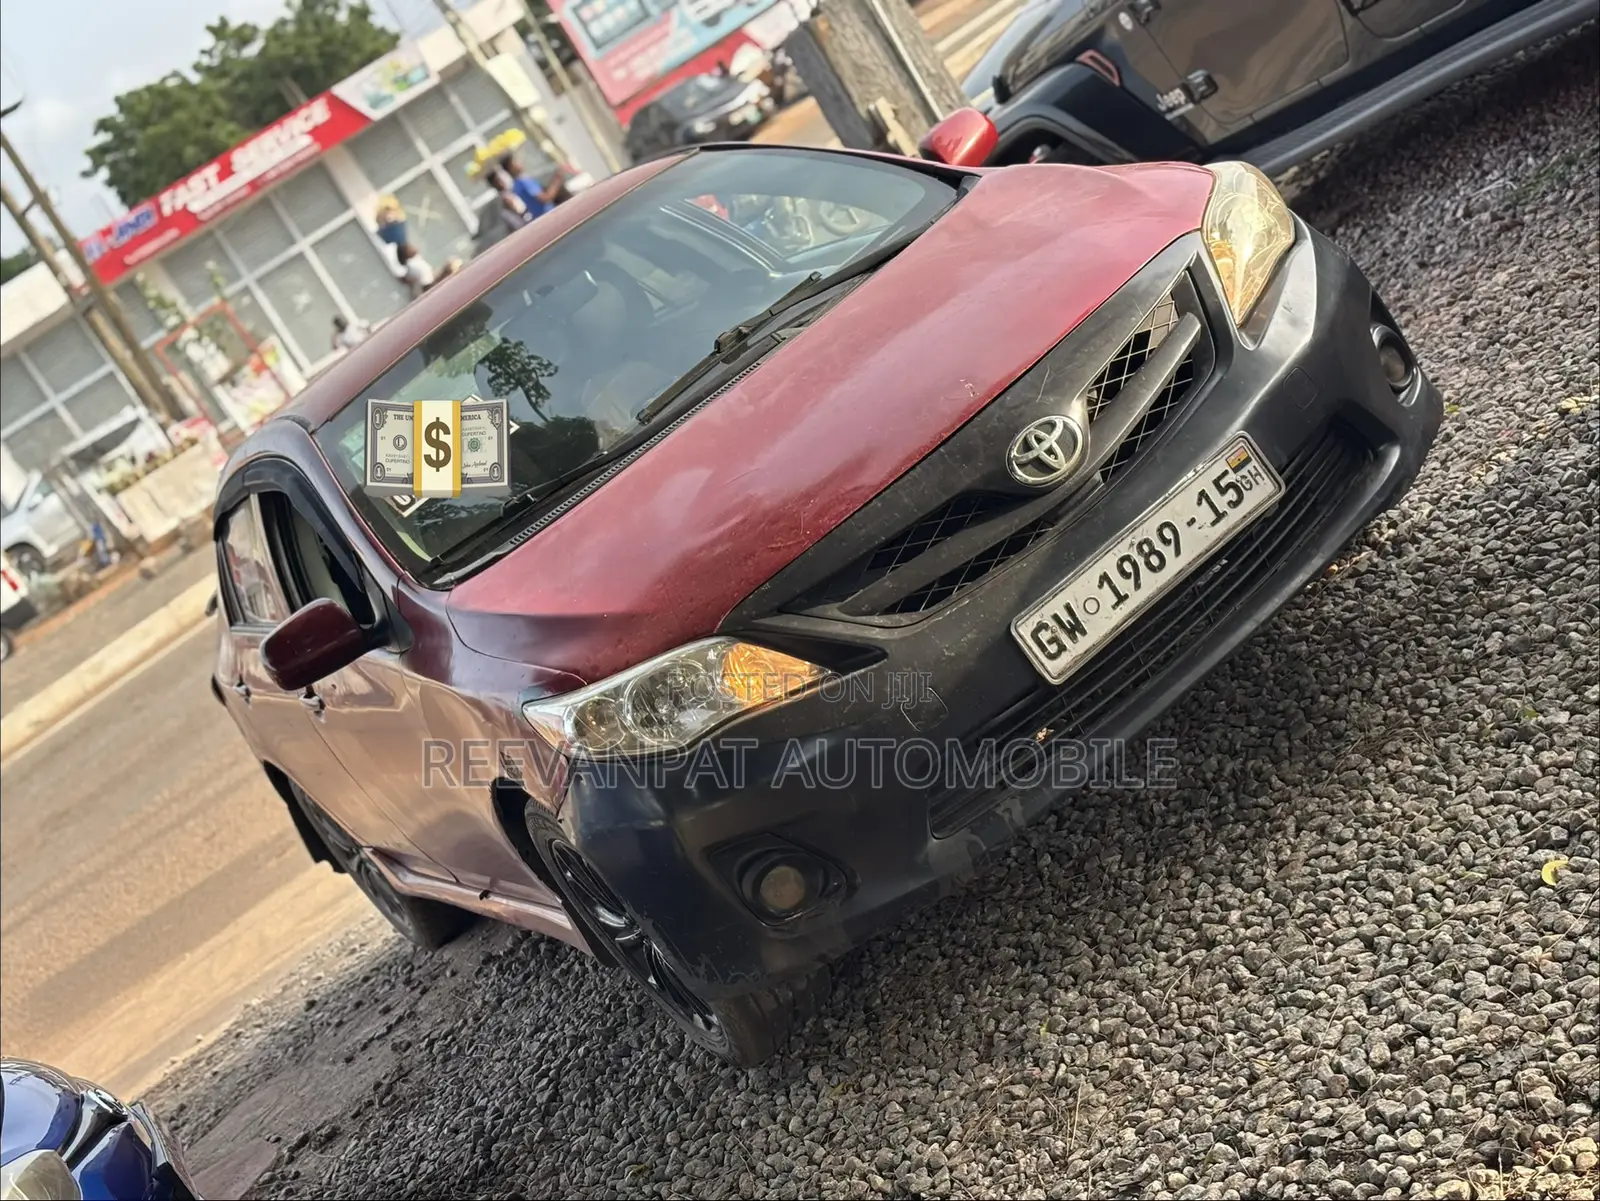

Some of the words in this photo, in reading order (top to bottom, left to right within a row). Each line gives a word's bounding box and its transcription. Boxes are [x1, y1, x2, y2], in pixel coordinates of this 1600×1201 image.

[1156, 87, 1186, 111] Jeep
[158, 162, 221, 217] FAST
[229, 97, 332, 173] SERVICE
[1240, 465, 1265, 491] GH
[1030, 602, 1088, 661] GW
